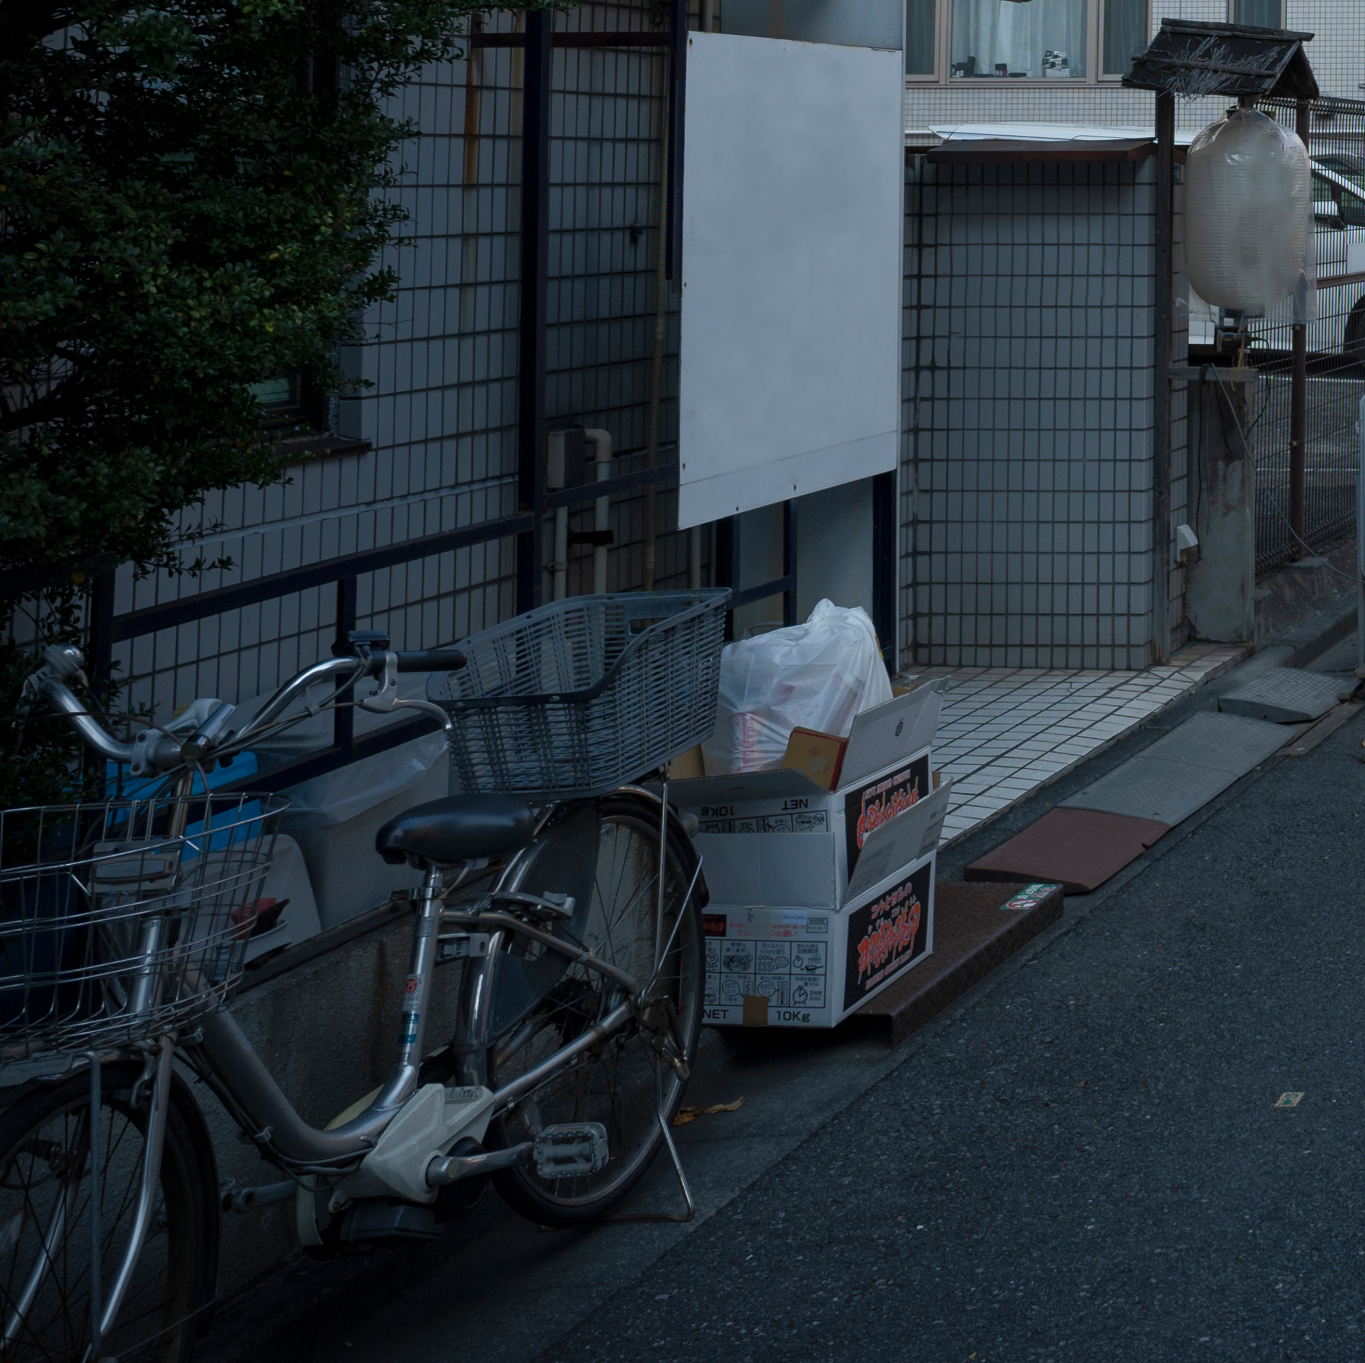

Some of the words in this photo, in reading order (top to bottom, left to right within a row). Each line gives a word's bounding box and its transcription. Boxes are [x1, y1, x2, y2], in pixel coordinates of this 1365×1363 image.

[782, 798, 808, 811] NET
[703, 1009, 729, 1019] NET
[776, 1011, 811, 1022] 10Kg
